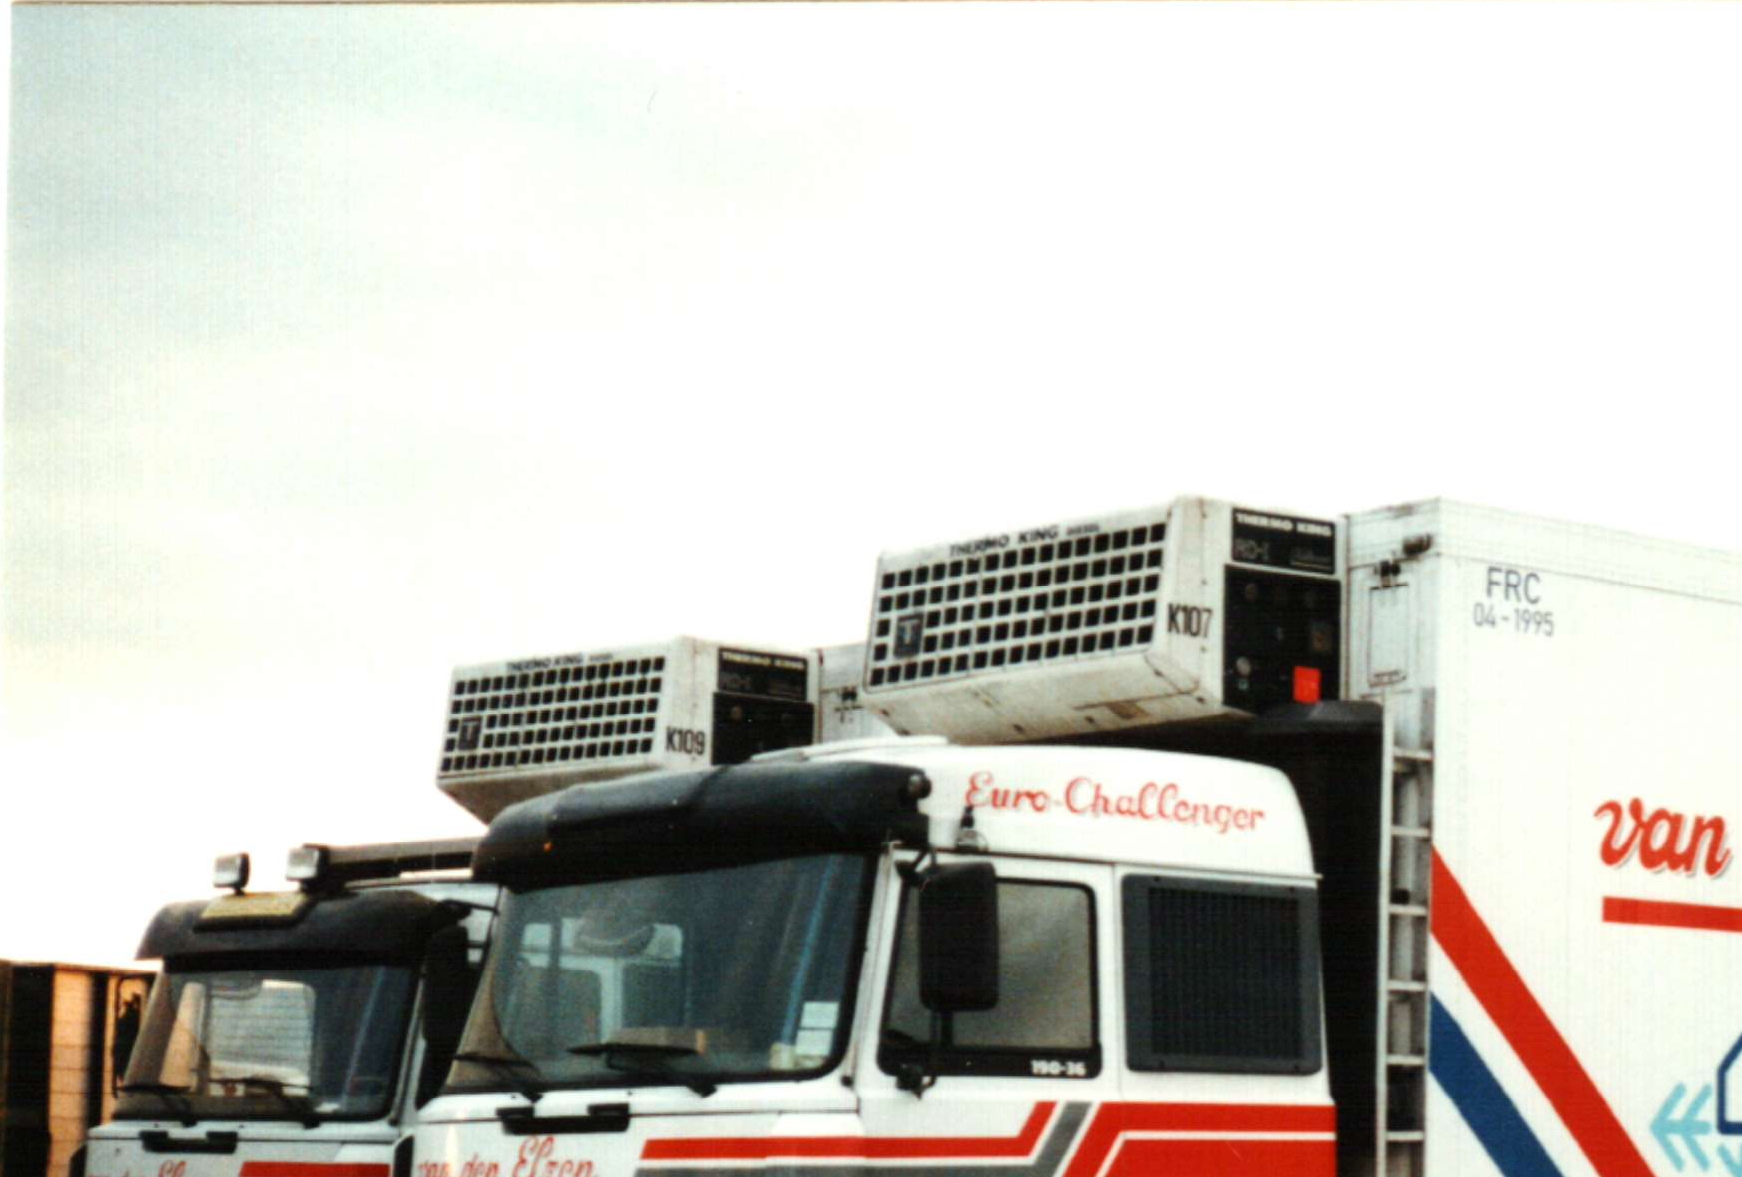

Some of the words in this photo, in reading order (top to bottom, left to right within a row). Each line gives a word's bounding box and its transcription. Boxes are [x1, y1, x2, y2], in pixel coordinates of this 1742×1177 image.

[950, 534, 1010, 557] THERMO
[1018, 524, 1059, 543] KING
[1236, 513, 1294, 532] THERMO
[1297, 522, 1332, 537] KING
[1486, 565, 1542, 605] FRC
[1167, 602, 1213, 638] K107
[665, 725, 706, 755] K109
[964, 770, 1050, 813] Euro
[1064, 776, 1266, 834] Challenger
[1594, 796, 1732, 877] van
